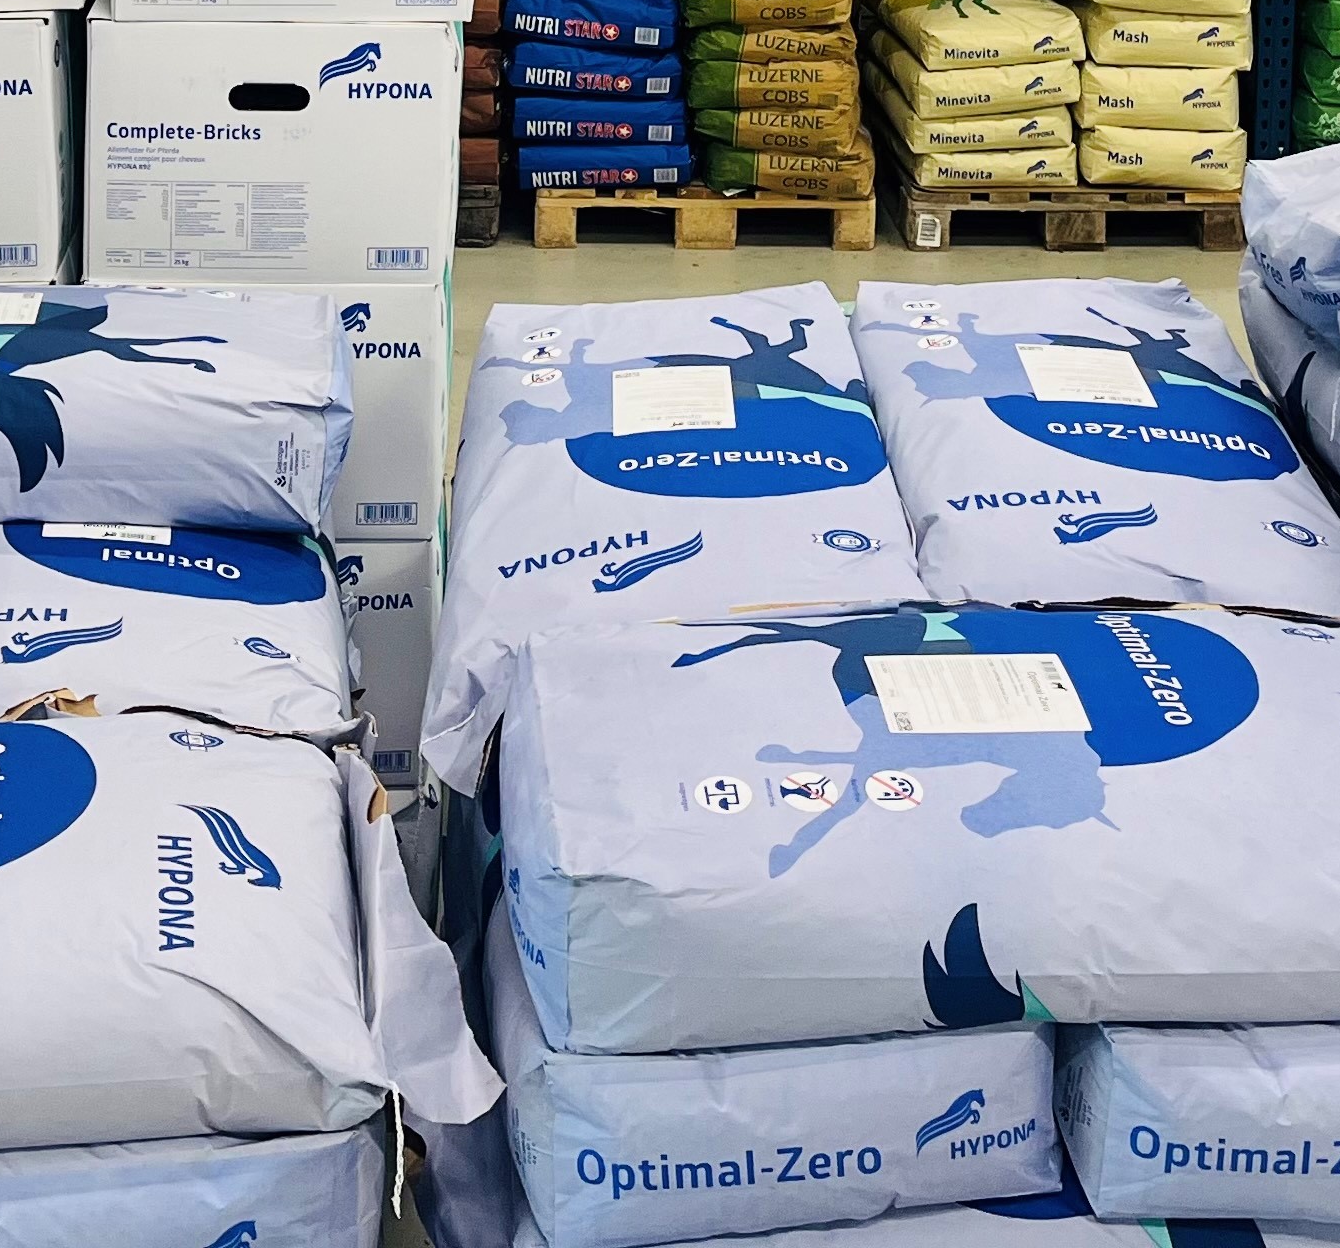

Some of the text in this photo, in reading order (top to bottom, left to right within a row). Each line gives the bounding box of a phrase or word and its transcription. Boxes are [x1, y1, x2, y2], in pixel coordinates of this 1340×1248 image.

[760, 6, 807, 20] COBS
[515, 13, 601, 39] NUTRI STAR
[1113, 29, 1149, 44] Mash
[944, 47, 999, 60] Minevita
[525, 67, 614, 91] NUTRI STAR
[748, 69, 824, 83] LUZERNE
[348, 82, 432, 100] HYPONA
[762, 89, 809, 104] COBS
[935, 93, 991, 107] Minevita
[1098, 95, 1134, 109] Mash
[526, 120, 614, 138] NUTRI STAR
[749, 111, 825, 129] LUZERNE
[106, 122, 261, 143] Complete-Bricks
[762, 134, 809, 148] COBS
[930, 133, 984, 144] Minevita
[769, 157, 843, 172] LUZERNE
[1107, 152, 1143, 166] Mash
[532, 169, 620, 187] NUTRI STAR
[937, 167, 993, 180] Minevita
[782, 177, 828, 190] COBS
[353, 341, 422, 359] YPONA
[1048, 421, 1272, 460] Optimal-Zero
[619, 450, 849, 473] Optimal-Zero
[948, 490, 1100, 511] HYPONA
[102, 547, 241, 581] Optimal
[498, 531, 648, 579] HYPONA
[1097, 612, 1194, 727] Optimal-Zero
[157, 835, 195, 953] HYPONA
[950, 1118, 1037, 1160] HYPONA
[577, 1144, 883, 1200] Optimal-Zero
